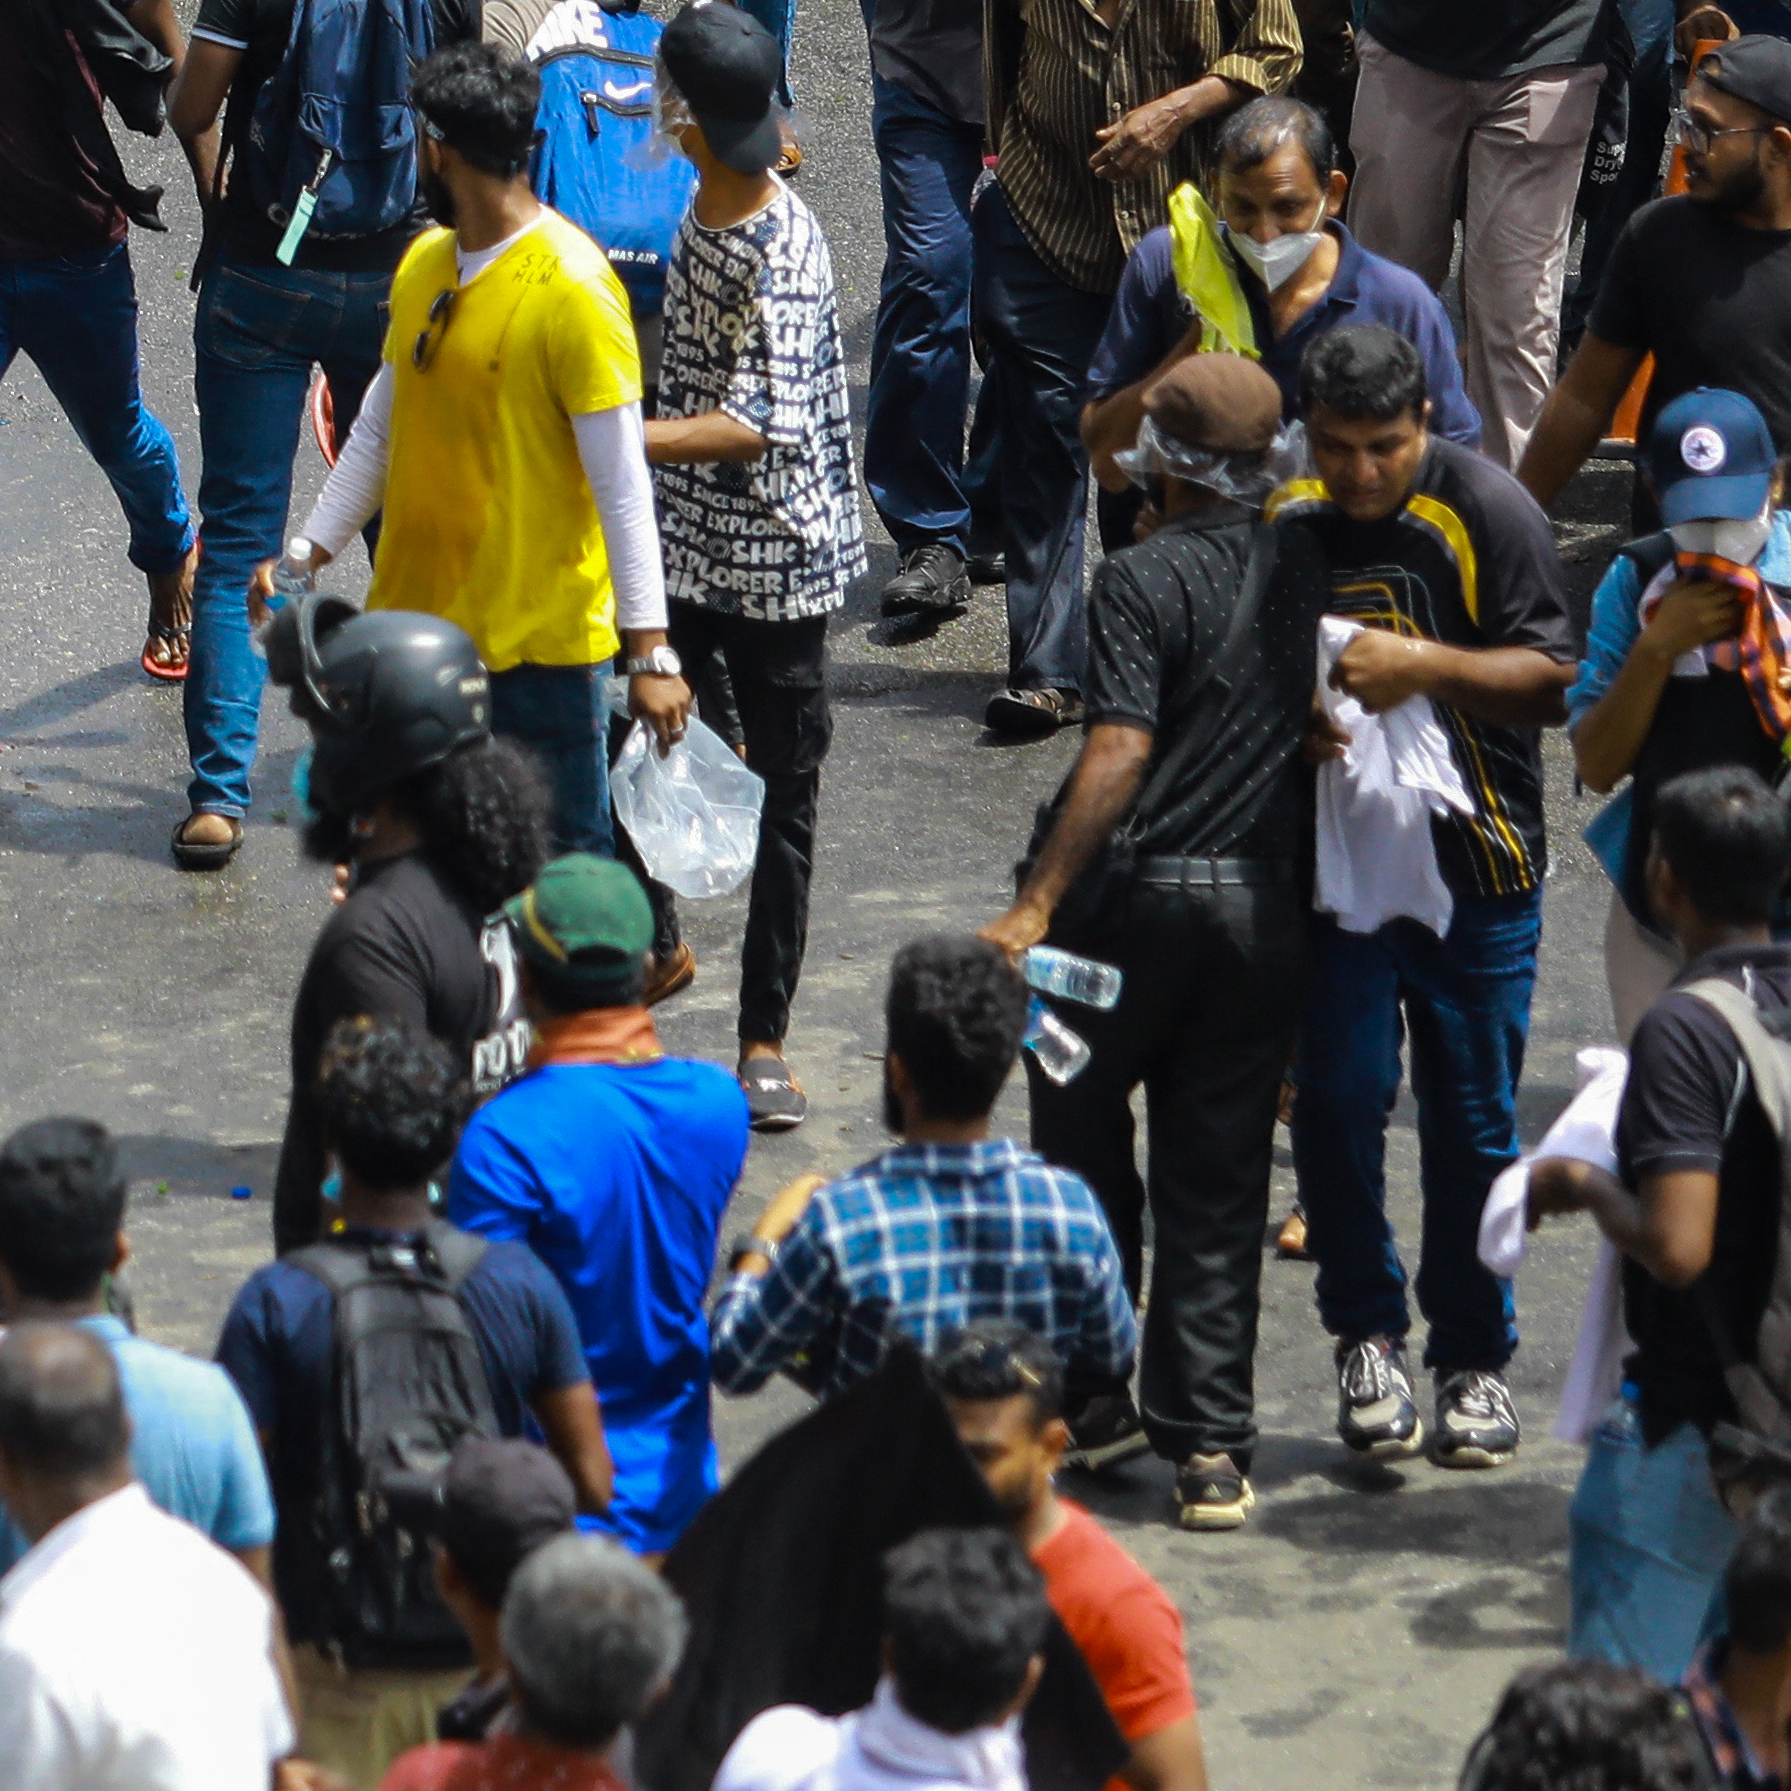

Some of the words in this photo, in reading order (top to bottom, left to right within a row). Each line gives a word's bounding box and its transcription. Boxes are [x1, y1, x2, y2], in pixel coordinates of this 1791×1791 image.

[607, 249, 634, 262] MAS
[635, 252, 659, 265] AIR
[731, 539, 798, 565] SHK
